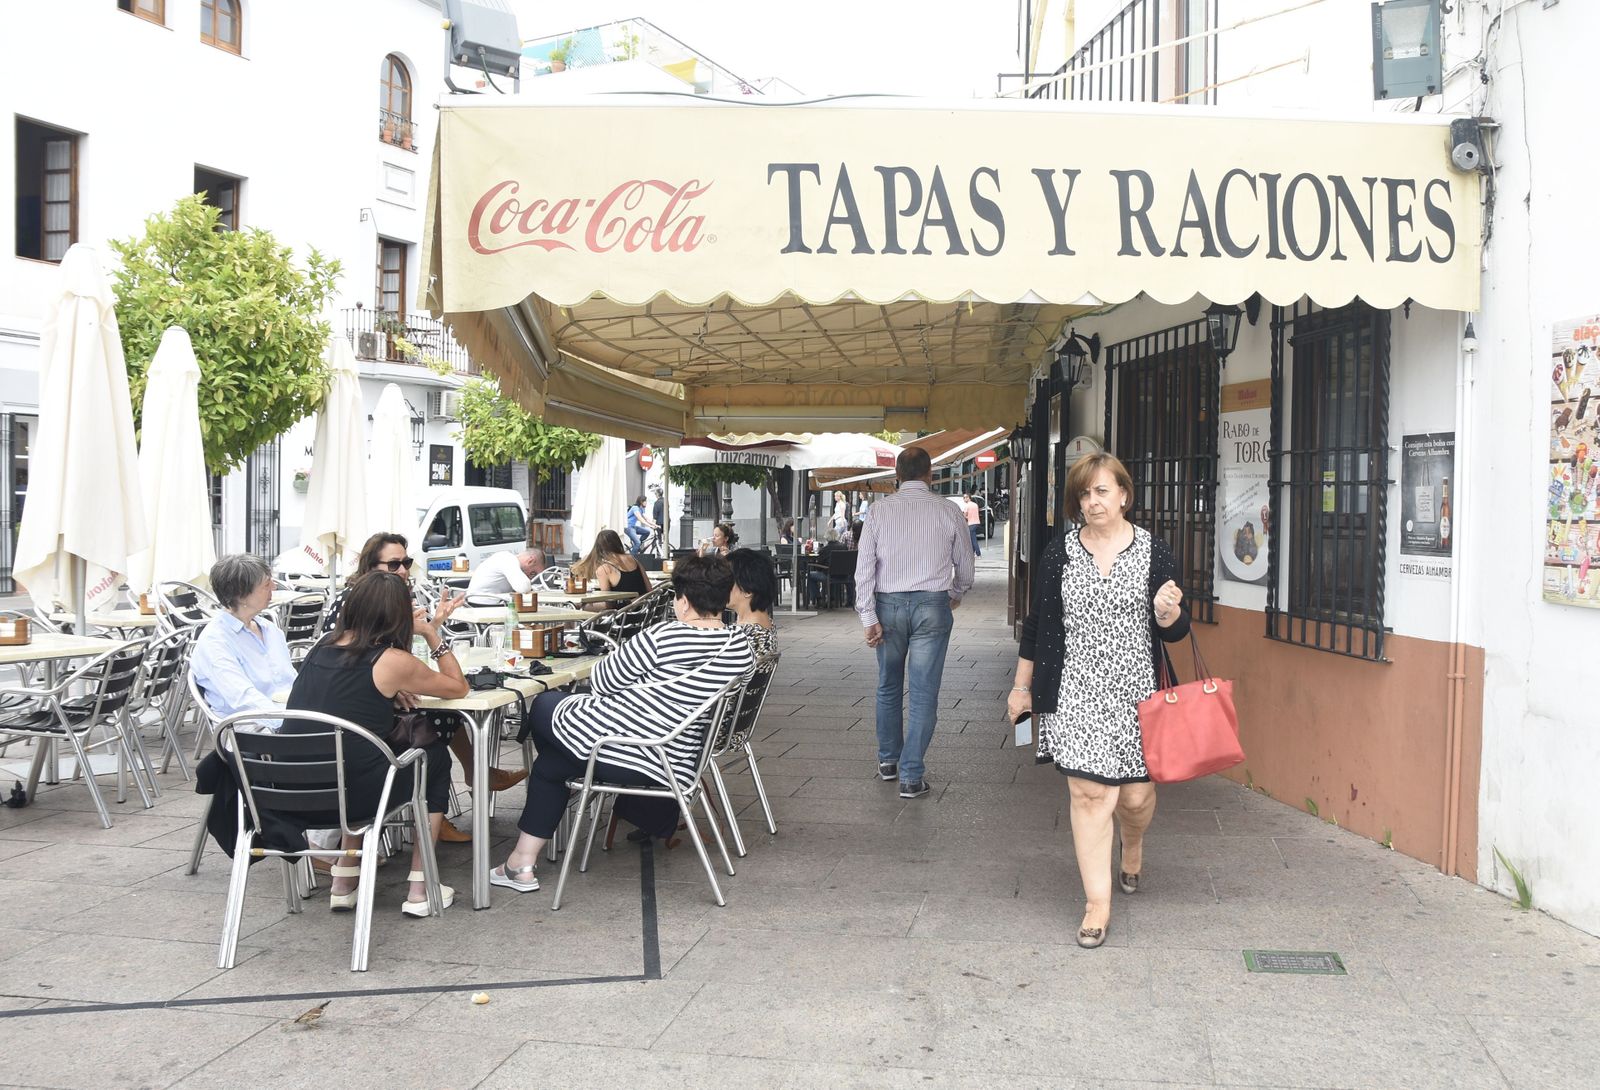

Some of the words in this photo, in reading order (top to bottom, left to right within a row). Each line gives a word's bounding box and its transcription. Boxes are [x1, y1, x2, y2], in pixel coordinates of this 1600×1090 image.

[468, 179, 715, 255] Coca-Cola
[767, 162, 1005, 257] TAPAS
[1031, 168, 1081, 256] Y
[1108, 168, 1456, 264] RACIONES
[1223, 421, 1250, 439] RABO
[1400, 563, 1424, 576] CERVEZAS
